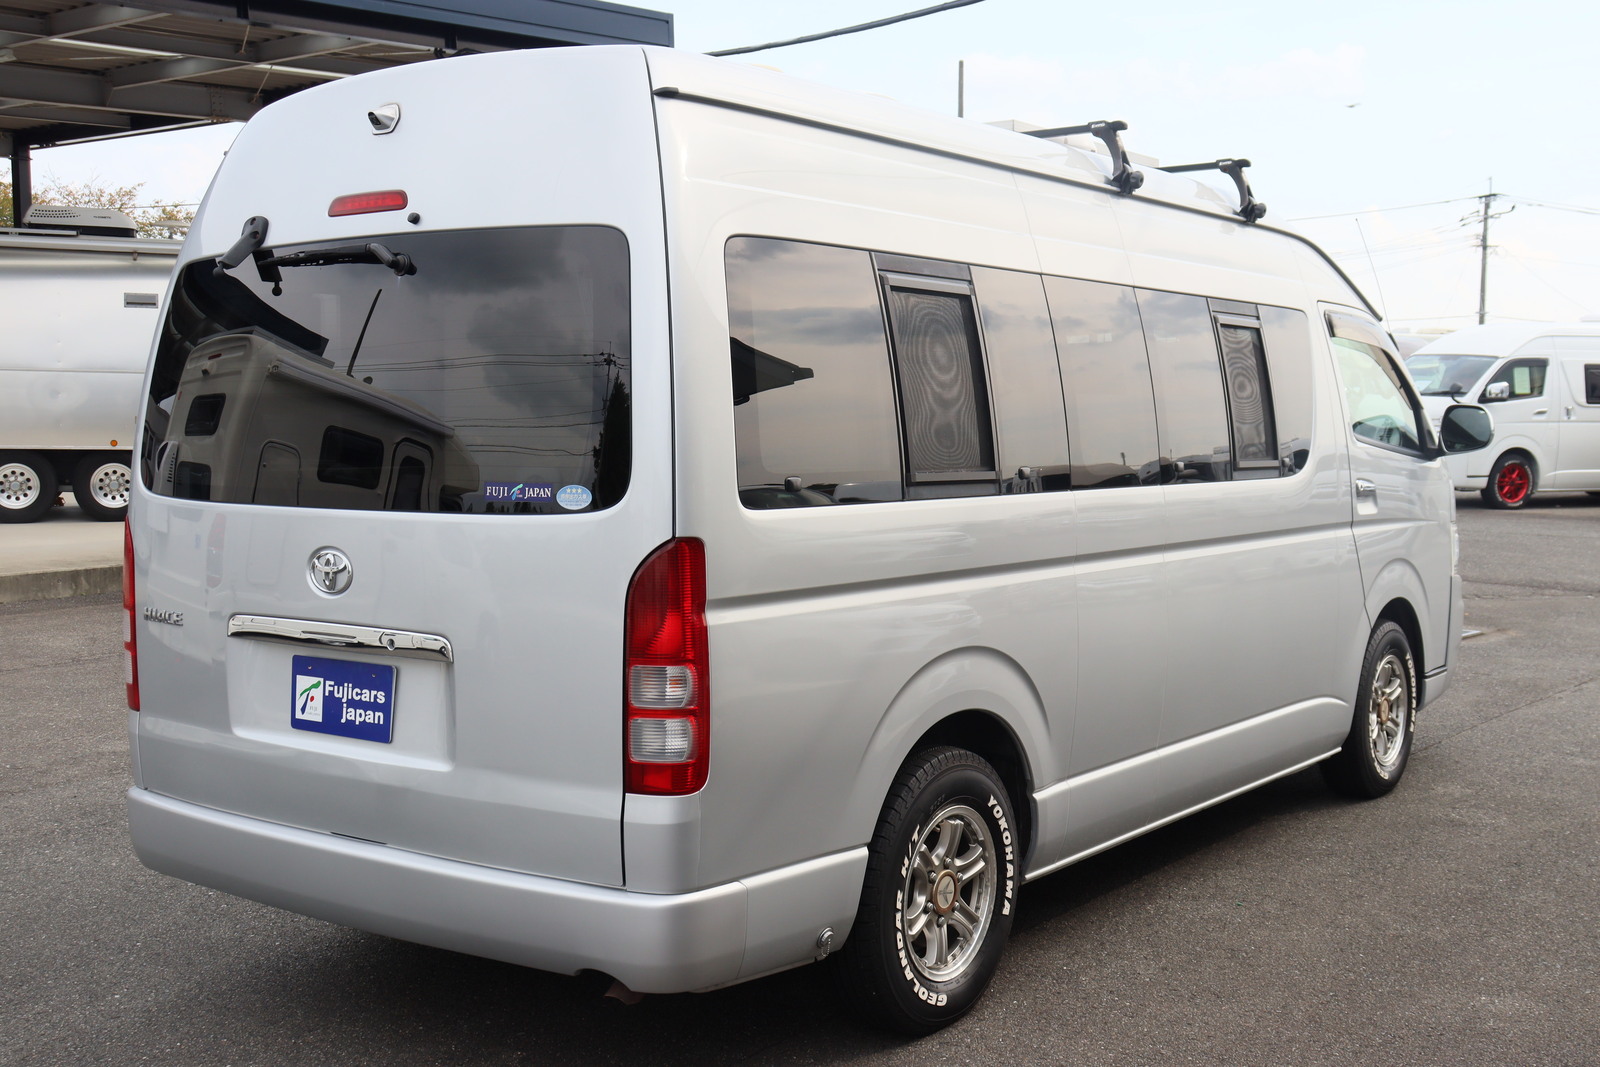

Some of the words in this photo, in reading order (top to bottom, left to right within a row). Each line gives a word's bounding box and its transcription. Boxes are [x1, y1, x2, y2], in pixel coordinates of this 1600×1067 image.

[486, 486, 508, 498] FUJI
[524, 487, 552, 499] JAPAN
[325, 680, 386, 704] Fujicars
[341, 703, 384, 725] japan
[988, 794, 1014, 916] YOKOHAMA
[895, 889, 948, 1007] GEOLANDAR
